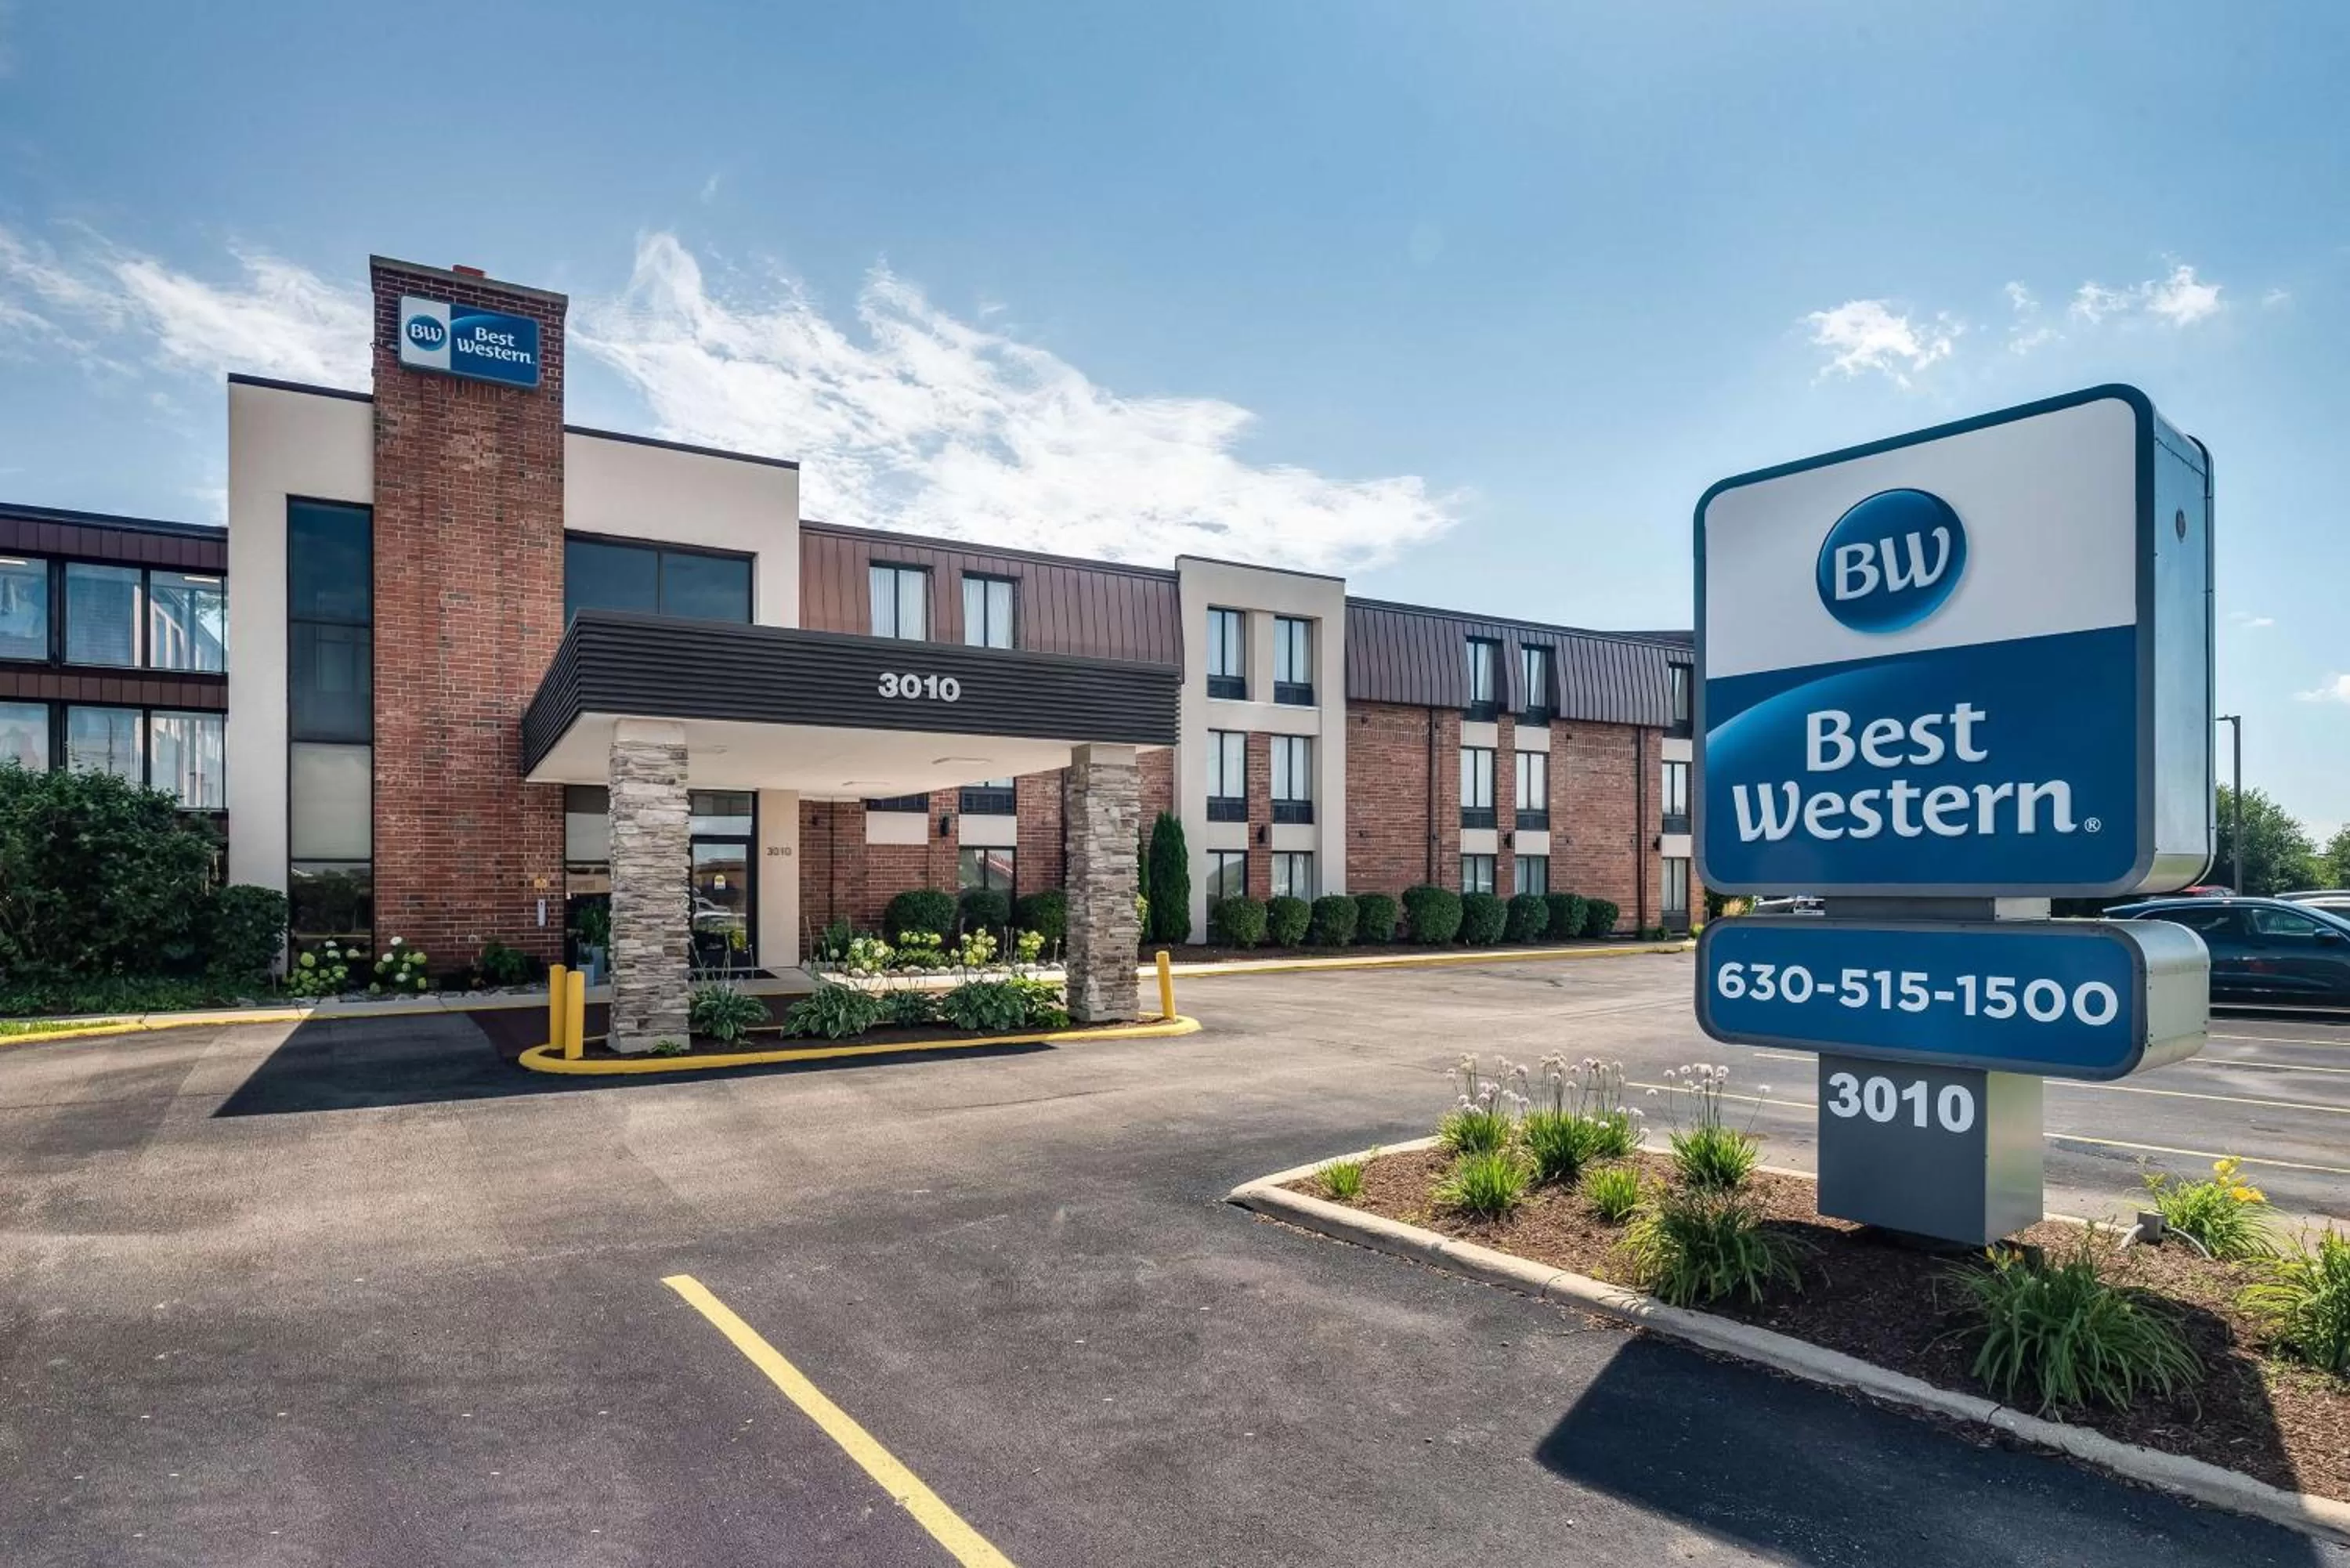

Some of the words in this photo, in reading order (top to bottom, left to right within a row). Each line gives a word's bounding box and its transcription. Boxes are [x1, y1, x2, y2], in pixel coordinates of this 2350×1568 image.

[410, 323, 442, 341] BW
[475, 327, 515, 347] Best
[457, 338, 532, 364] Western
[1835, 526, 1951, 601] BW
[878, 673, 961, 703] 3010
[1806, 703, 1988, 771] Best
[767, 847, 791, 856] 3010
[1717, 962, 2119, 1026] 630-515-1500
[1828, 1072, 1975, 1133] 3010
